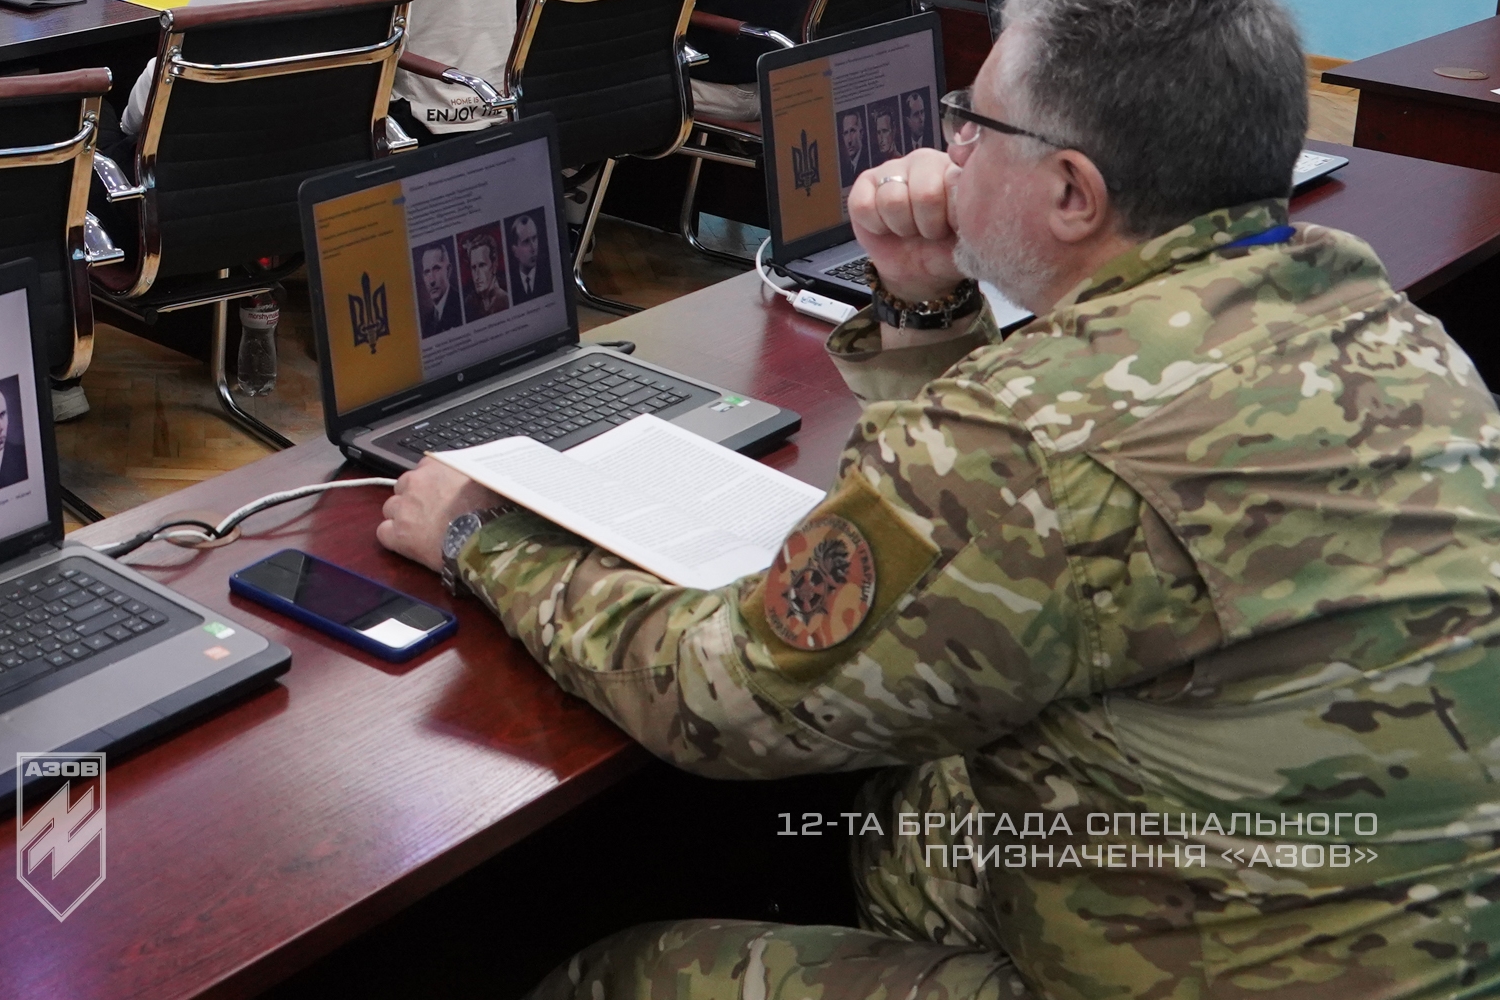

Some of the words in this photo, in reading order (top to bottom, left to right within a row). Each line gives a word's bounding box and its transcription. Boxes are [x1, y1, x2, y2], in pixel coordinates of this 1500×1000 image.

[450, 97, 472, 106] HOME
[473, 96, 479, 104] IS
[427, 105, 478, 122] ENJOY
